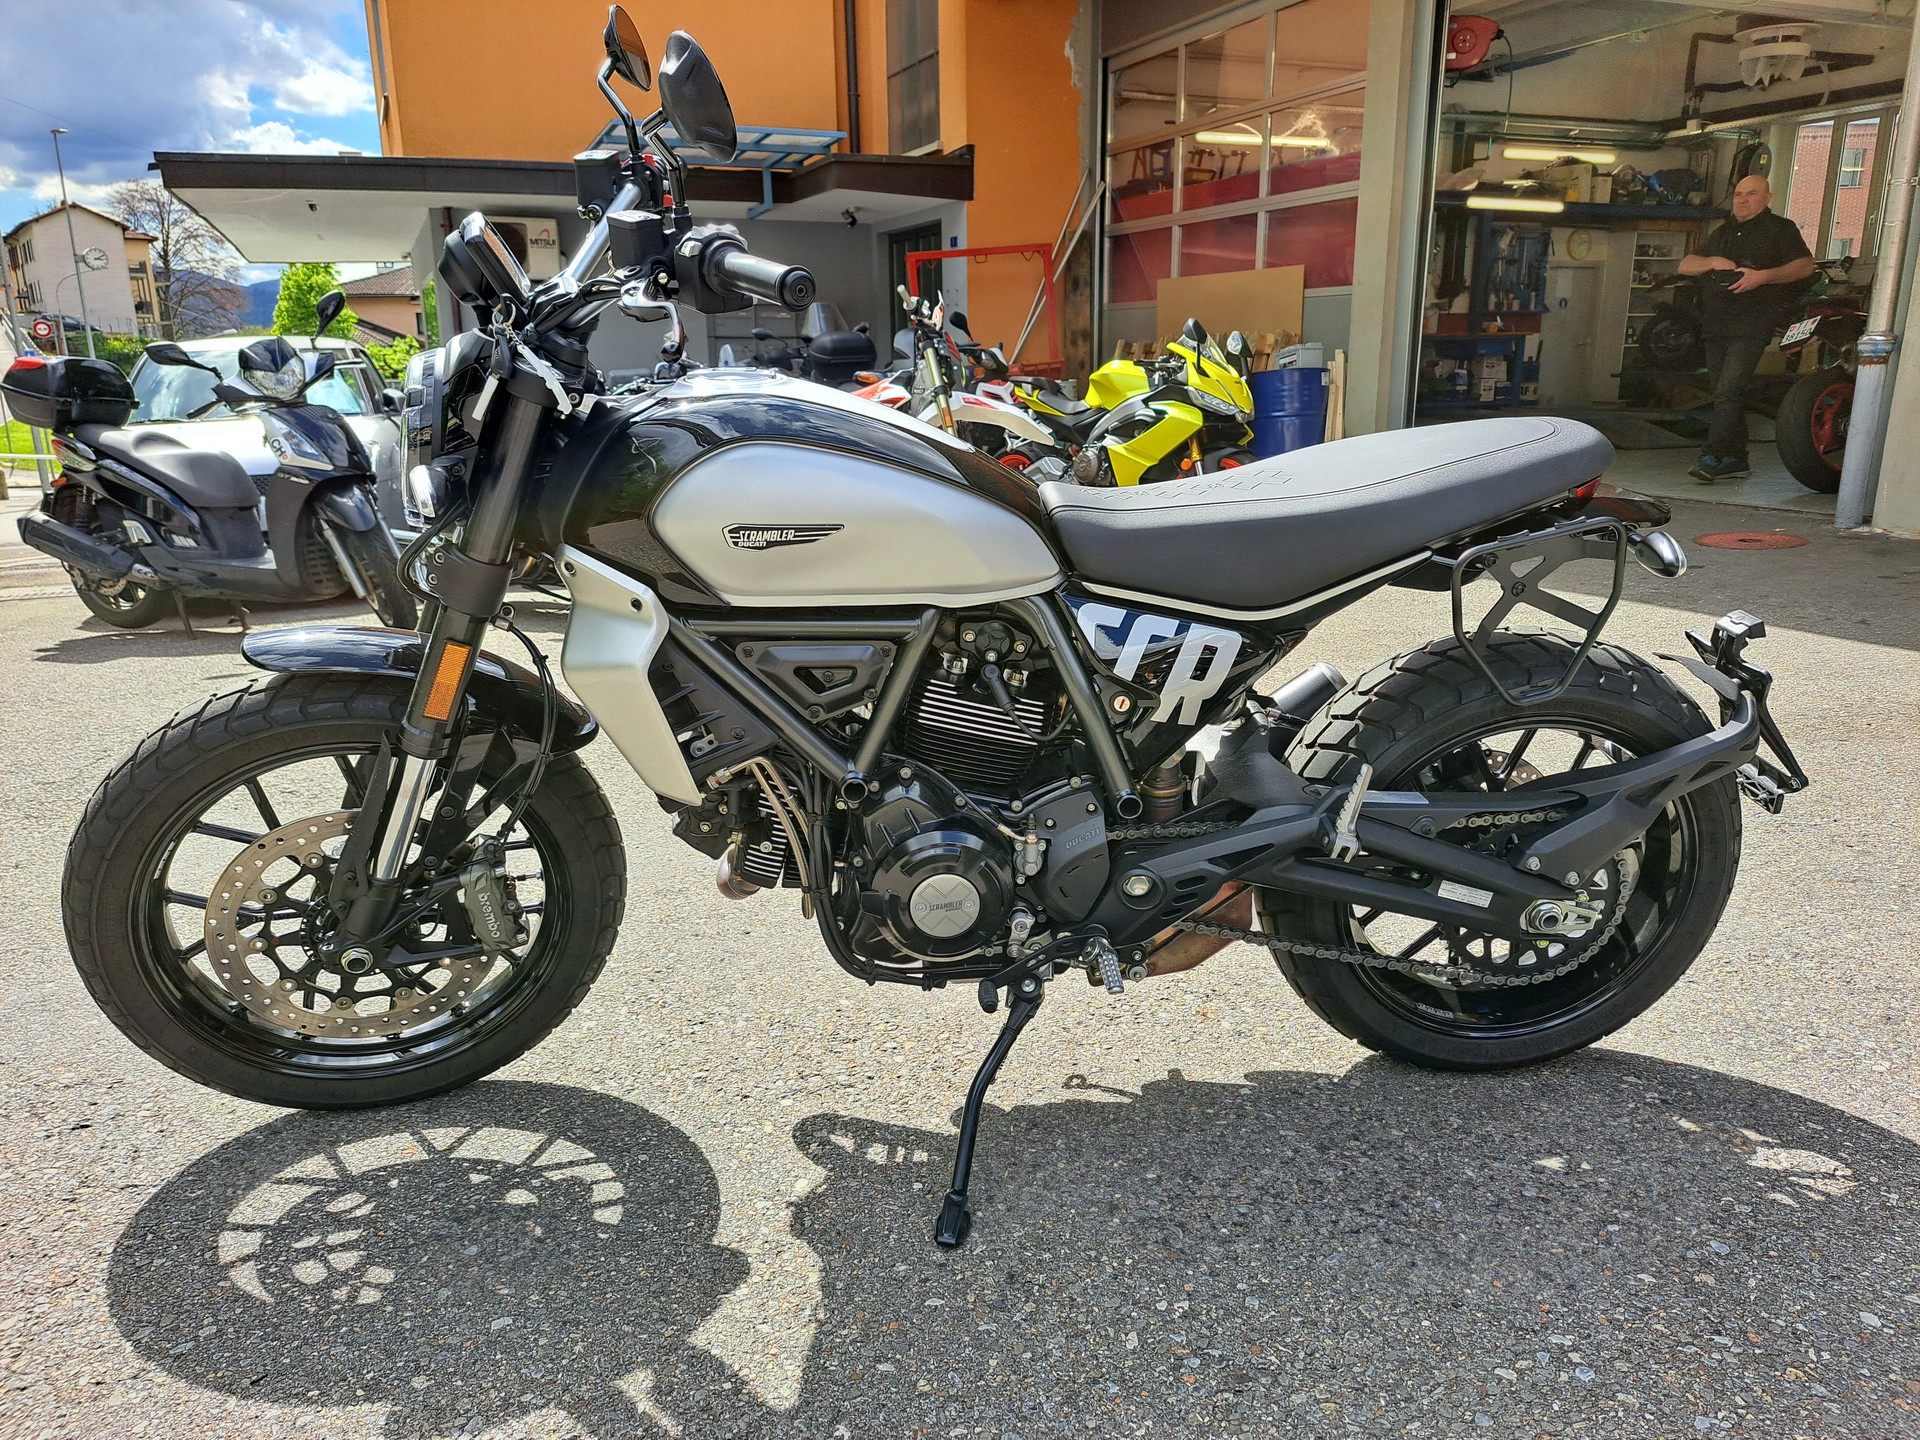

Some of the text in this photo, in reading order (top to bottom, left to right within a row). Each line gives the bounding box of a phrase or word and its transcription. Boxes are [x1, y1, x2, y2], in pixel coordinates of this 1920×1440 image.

[271, 438, 286, 457] CH
[738, 529, 796, 542] SCRAMBLER
[1065, 828, 1100, 849] DUCATI
[477, 891, 501, 938] brembo
[929, 900, 963, 912] SCRAMBLER
